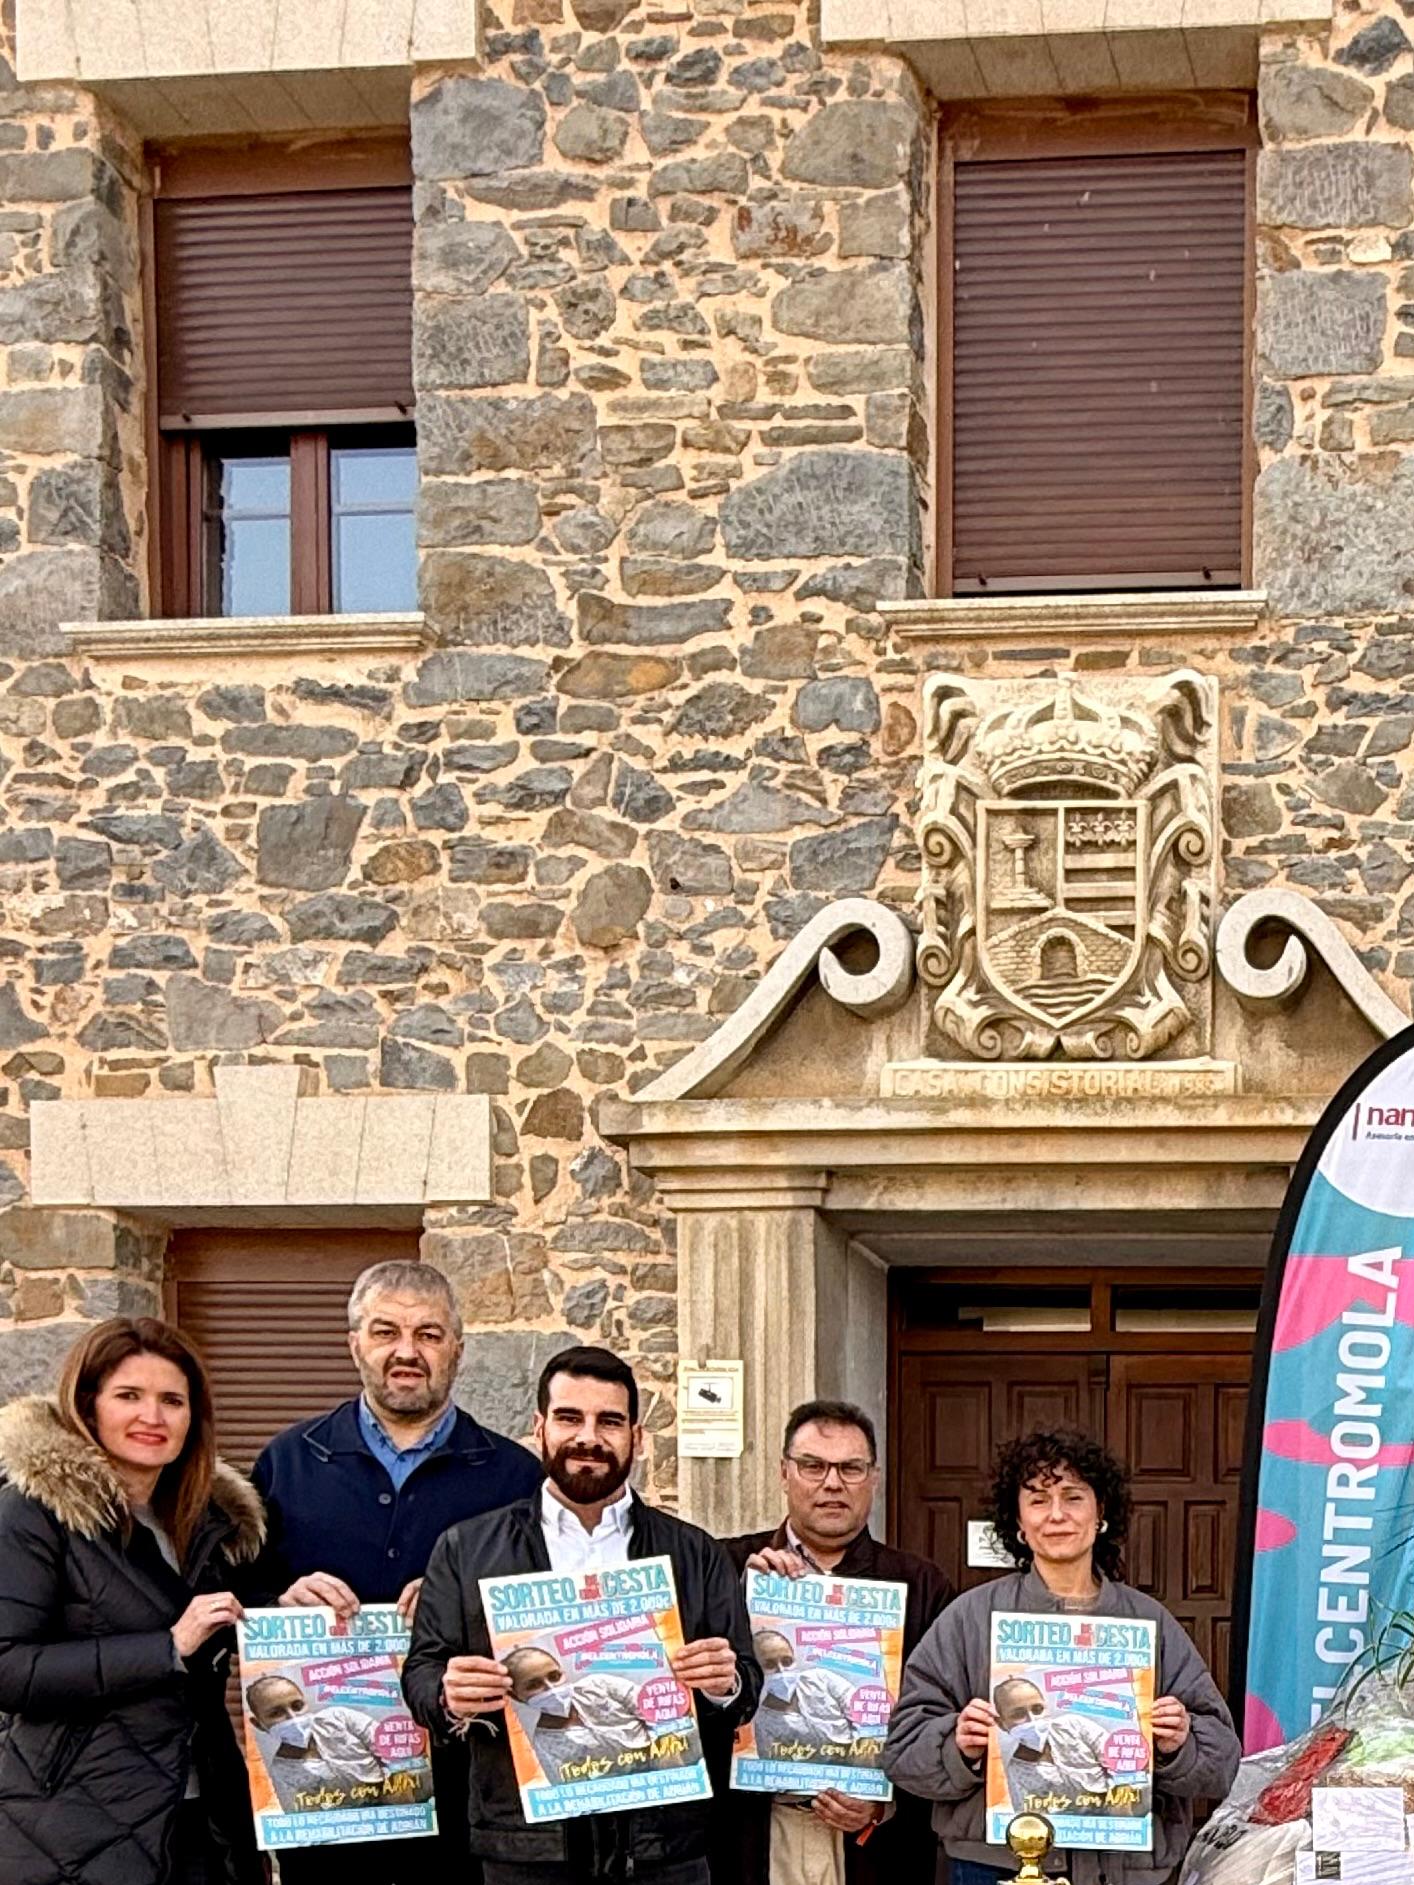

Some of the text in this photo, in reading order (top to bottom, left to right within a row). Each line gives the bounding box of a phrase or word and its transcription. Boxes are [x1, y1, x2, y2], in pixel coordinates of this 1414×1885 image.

[1311, 1246, 1402, 1727] LCENTROMOLA
[487, 1576, 577, 1614] SORTEO
[599, 1565, 671, 1598] CESTA
[497, 1609, 561, 1631] VALORADA
[563, 1607, 580, 1622] EN
[611, 1600, 629, 1616] DE
